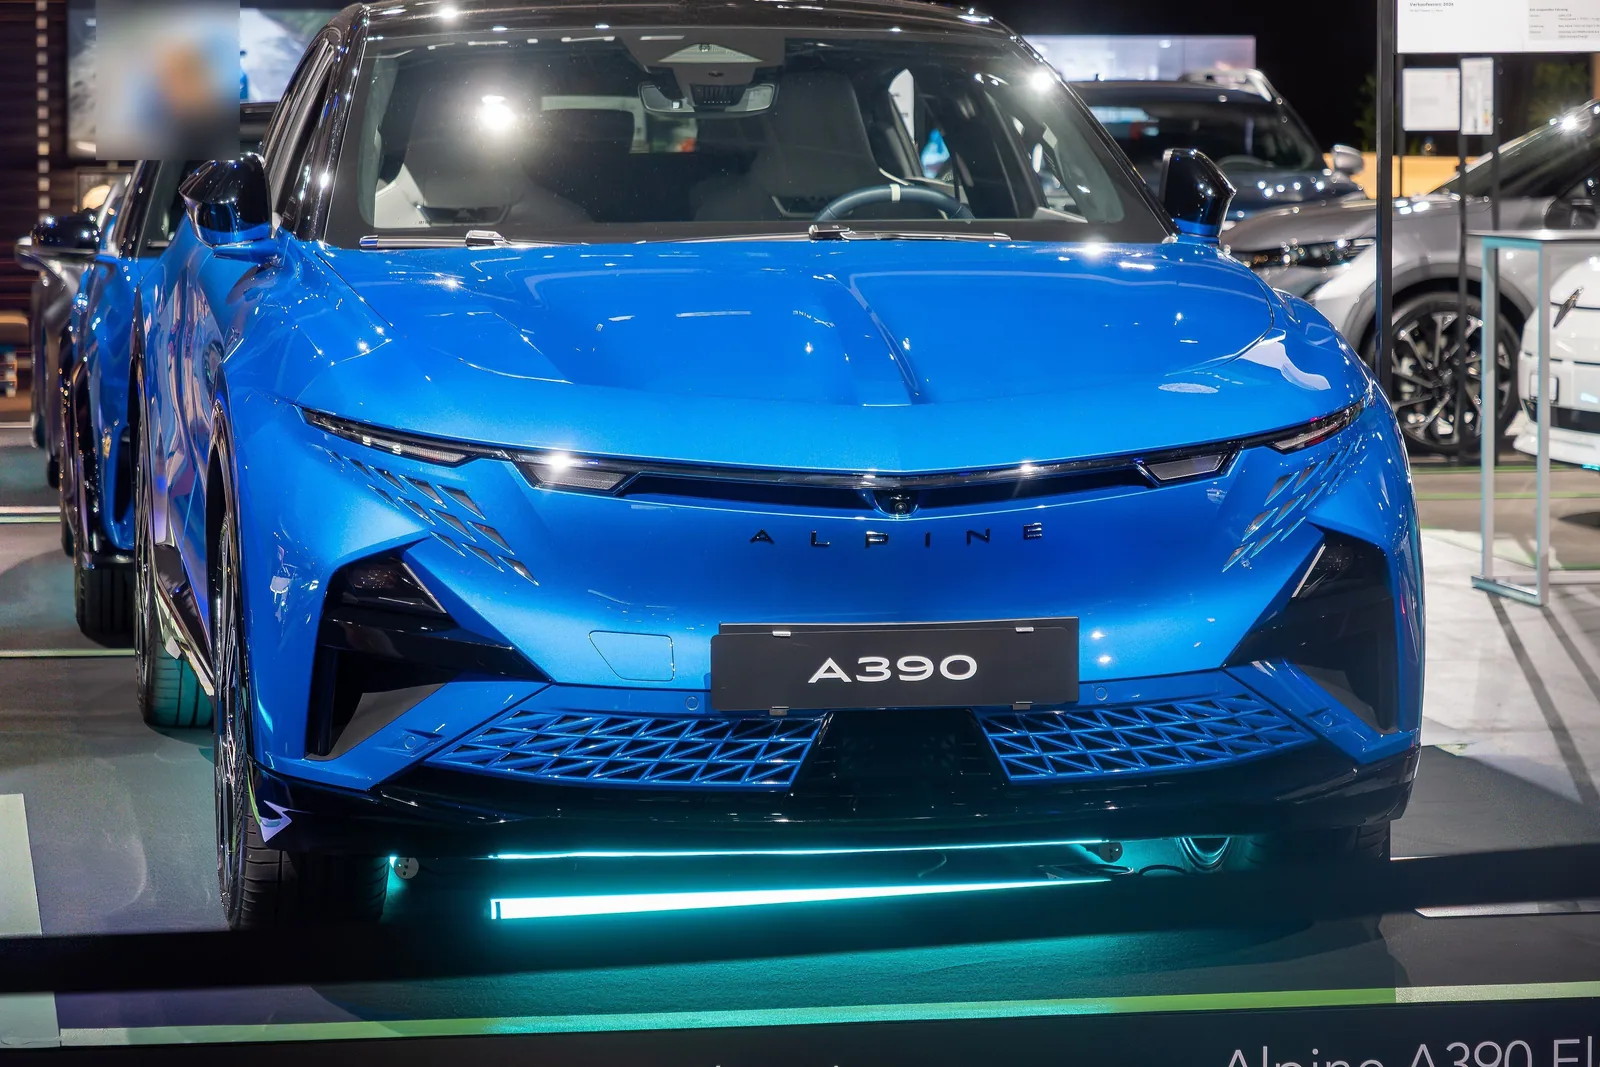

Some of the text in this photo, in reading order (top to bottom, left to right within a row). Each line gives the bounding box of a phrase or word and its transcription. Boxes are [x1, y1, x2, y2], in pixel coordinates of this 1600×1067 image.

[750, 522, 1043, 548] ALPINE
[808, 654, 978, 683] A390
[1553, 1035, 1600, 1067] El
